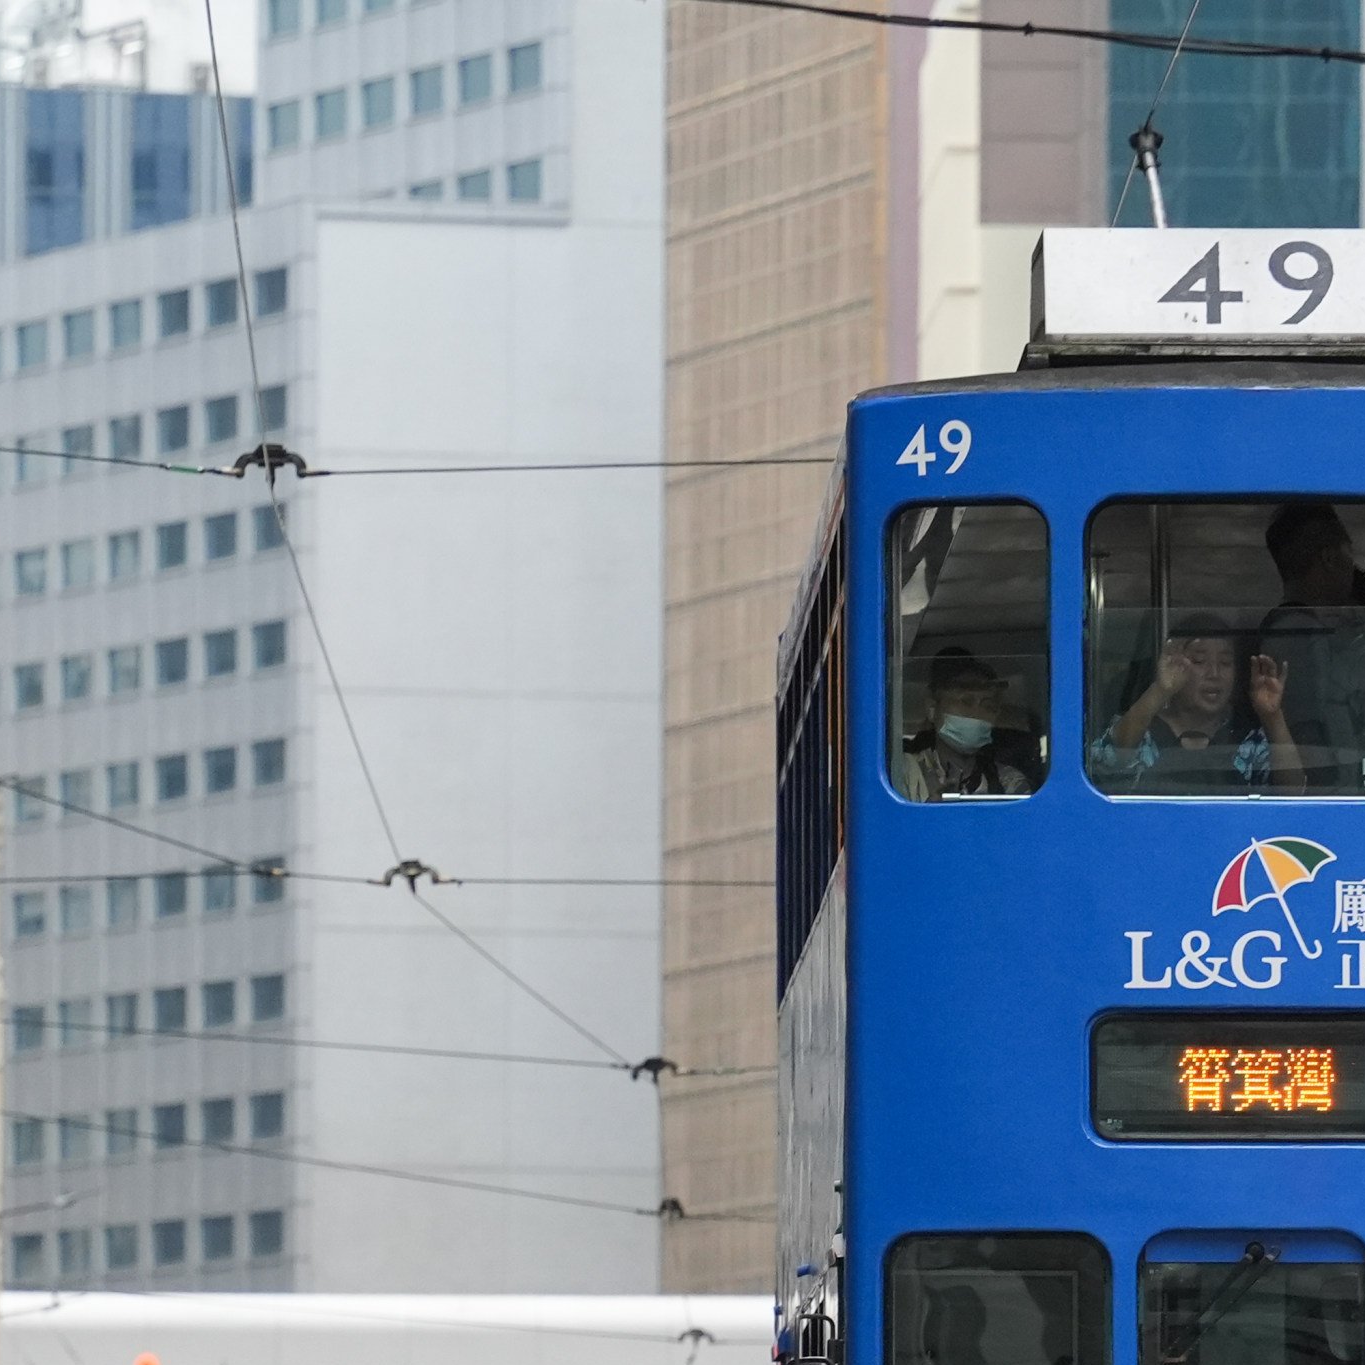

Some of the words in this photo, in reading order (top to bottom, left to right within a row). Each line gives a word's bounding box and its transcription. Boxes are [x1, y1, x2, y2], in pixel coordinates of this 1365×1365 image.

[1157, 241, 1334, 325] 49
[895, 419, 972, 477] 49
[1123, 930, 1288, 990] L&G
[1178, 1048, 1335, 1112] 筲箕灣
